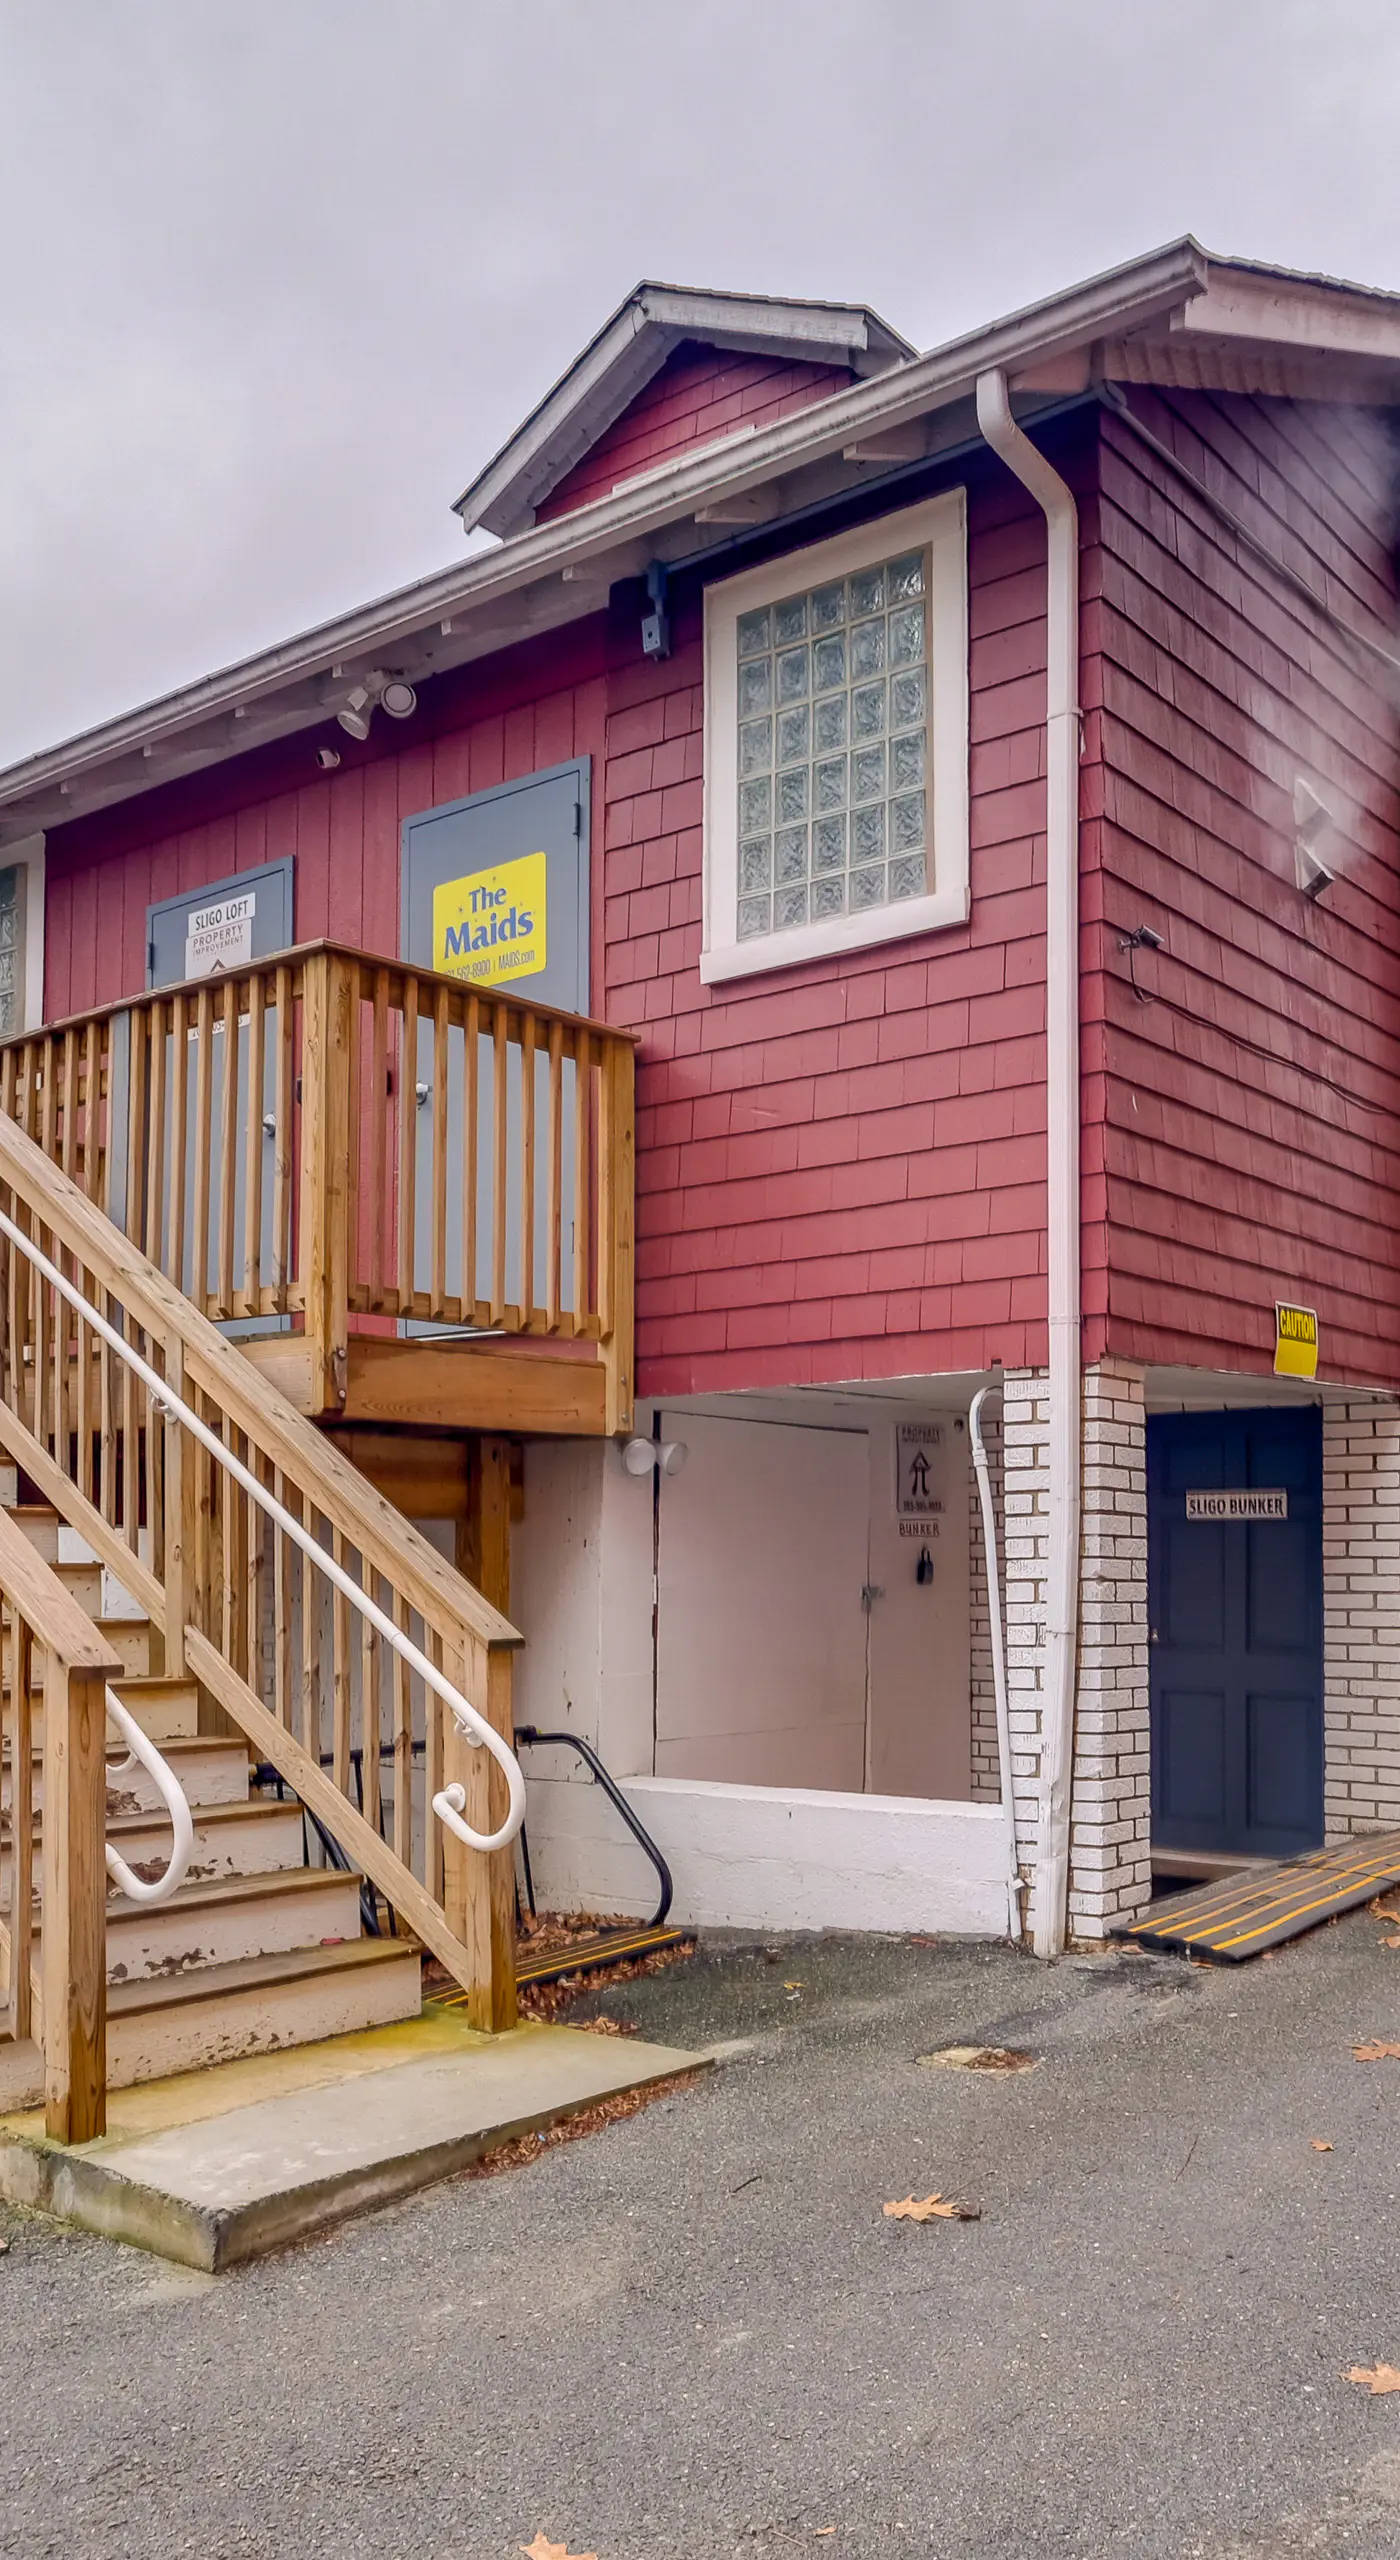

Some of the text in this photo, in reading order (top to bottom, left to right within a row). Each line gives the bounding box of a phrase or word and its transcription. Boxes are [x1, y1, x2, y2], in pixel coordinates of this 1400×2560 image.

[468, 885, 507, 913] The
[195, 900, 248, 931] SLIGO LOFT
[193, 924, 243, 948] PROPERTY
[443, 906, 534, 960] Maids
[1280, 1308, 1315, 1341] CAUTION
[1189, 1497, 1284, 1516] SLIGO BUNKER
[899, 1522, 940, 1537] BUNKER
